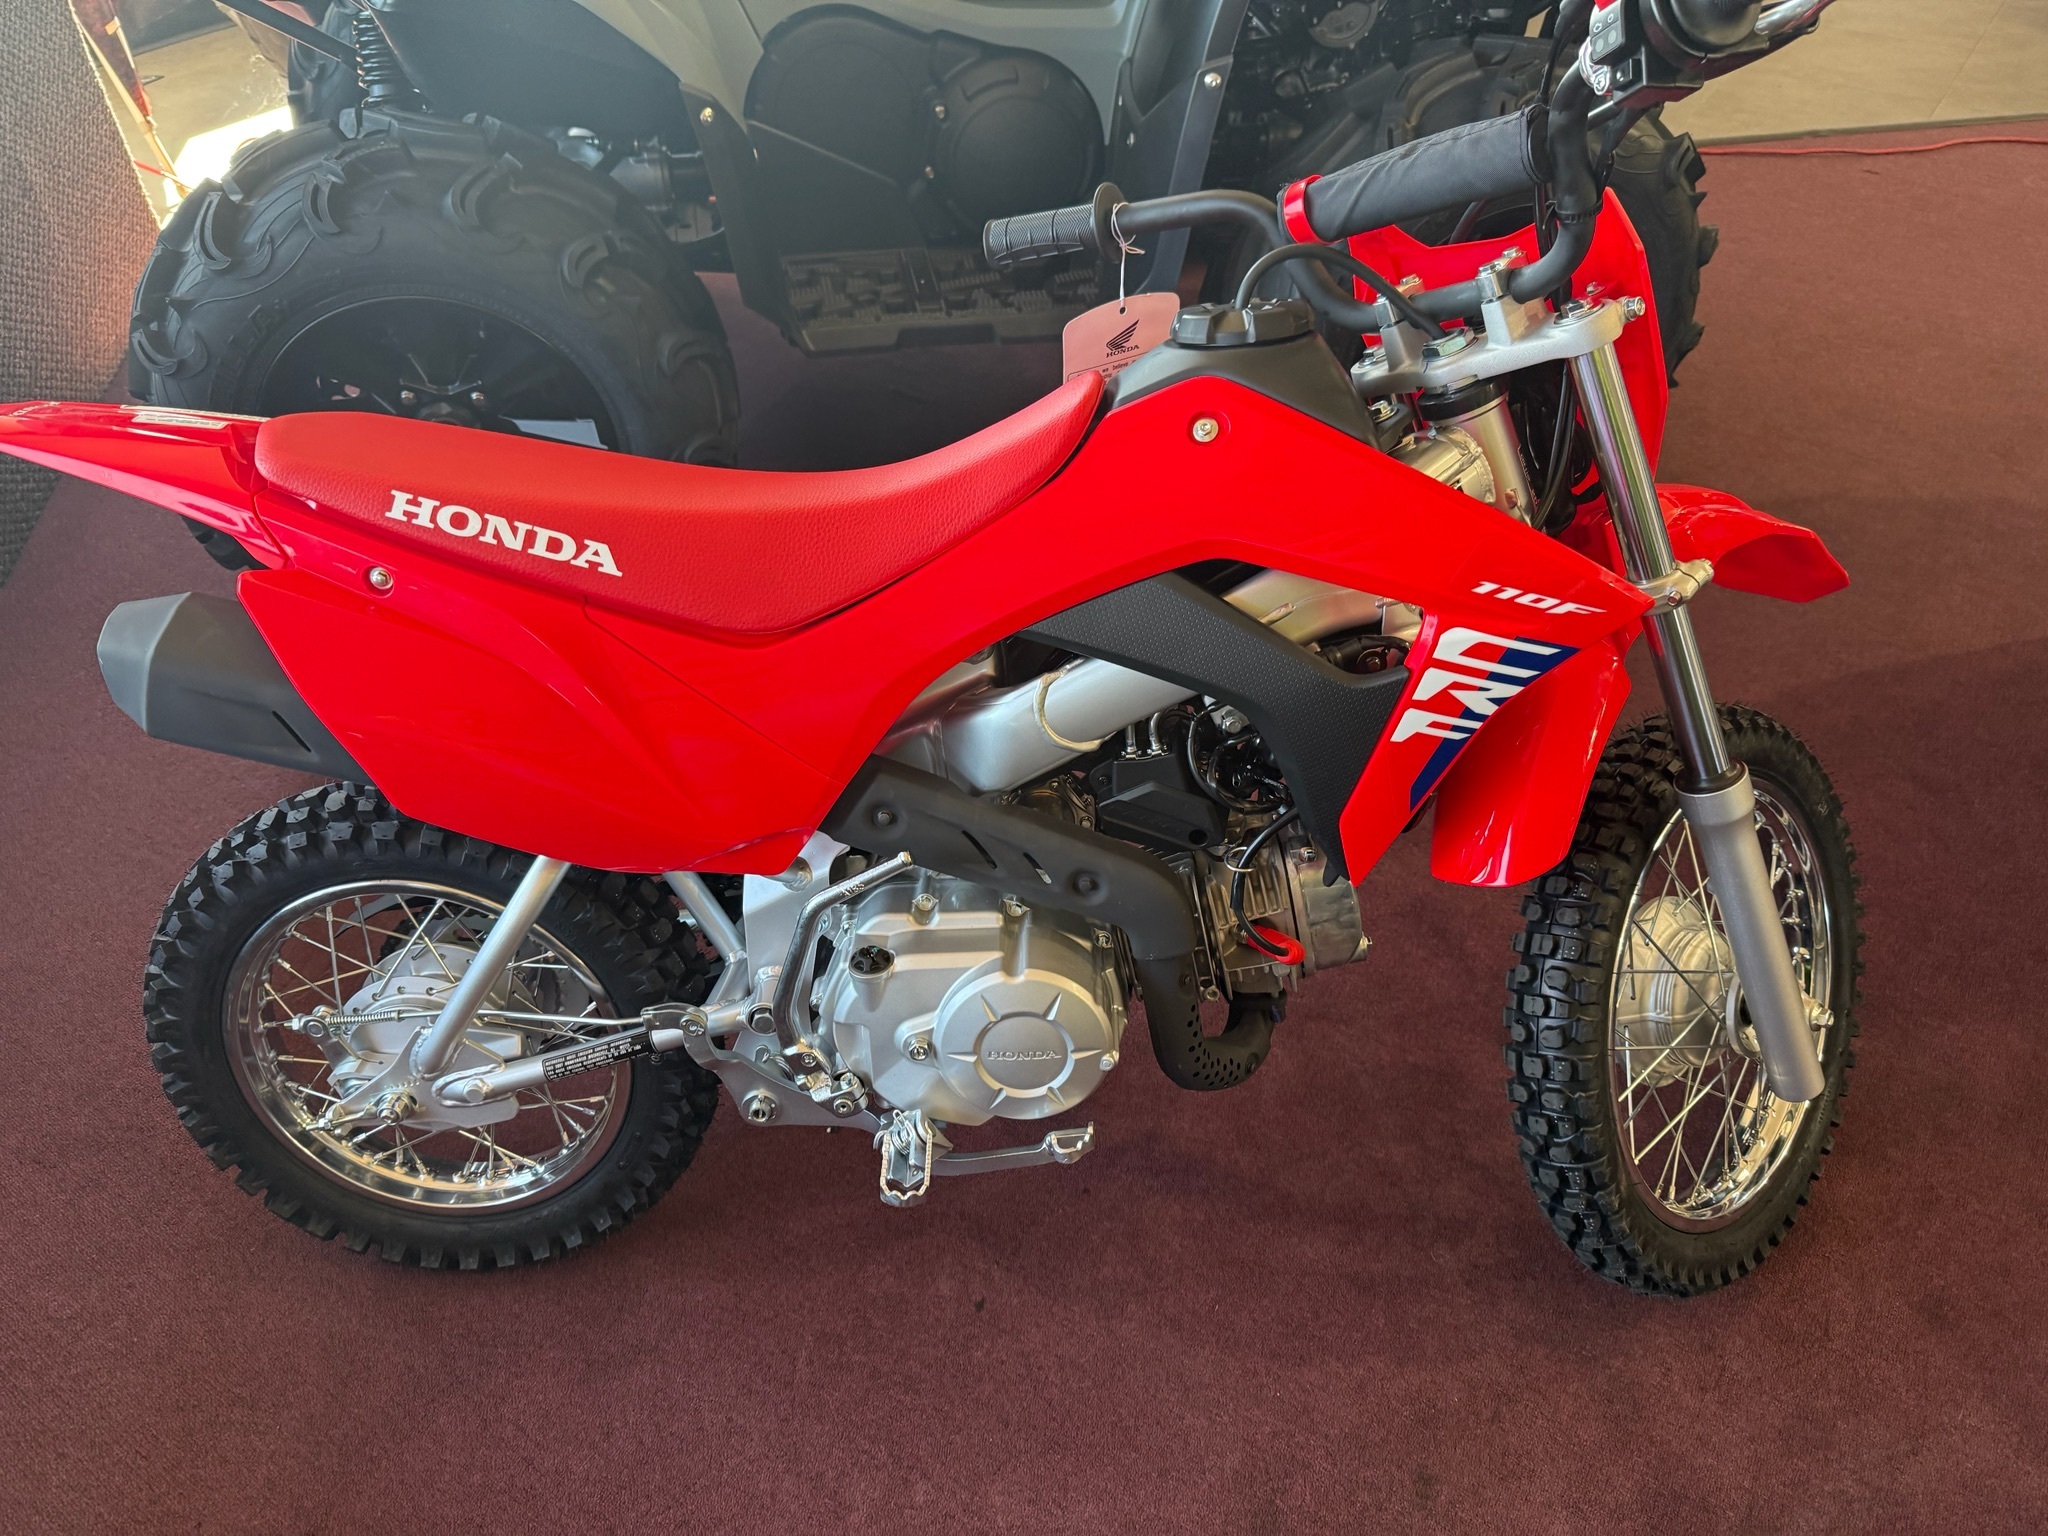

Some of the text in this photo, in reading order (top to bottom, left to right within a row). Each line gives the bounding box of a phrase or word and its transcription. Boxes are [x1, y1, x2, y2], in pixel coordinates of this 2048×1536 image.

[1106, 344, 1140, 358] HONDA
[385, 489, 623, 577] HONDA
[1471, 580, 1608, 614] 110F
[1390, 626, 1562, 743] CRF
[986, 1050, 1061, 1060] HONDA
